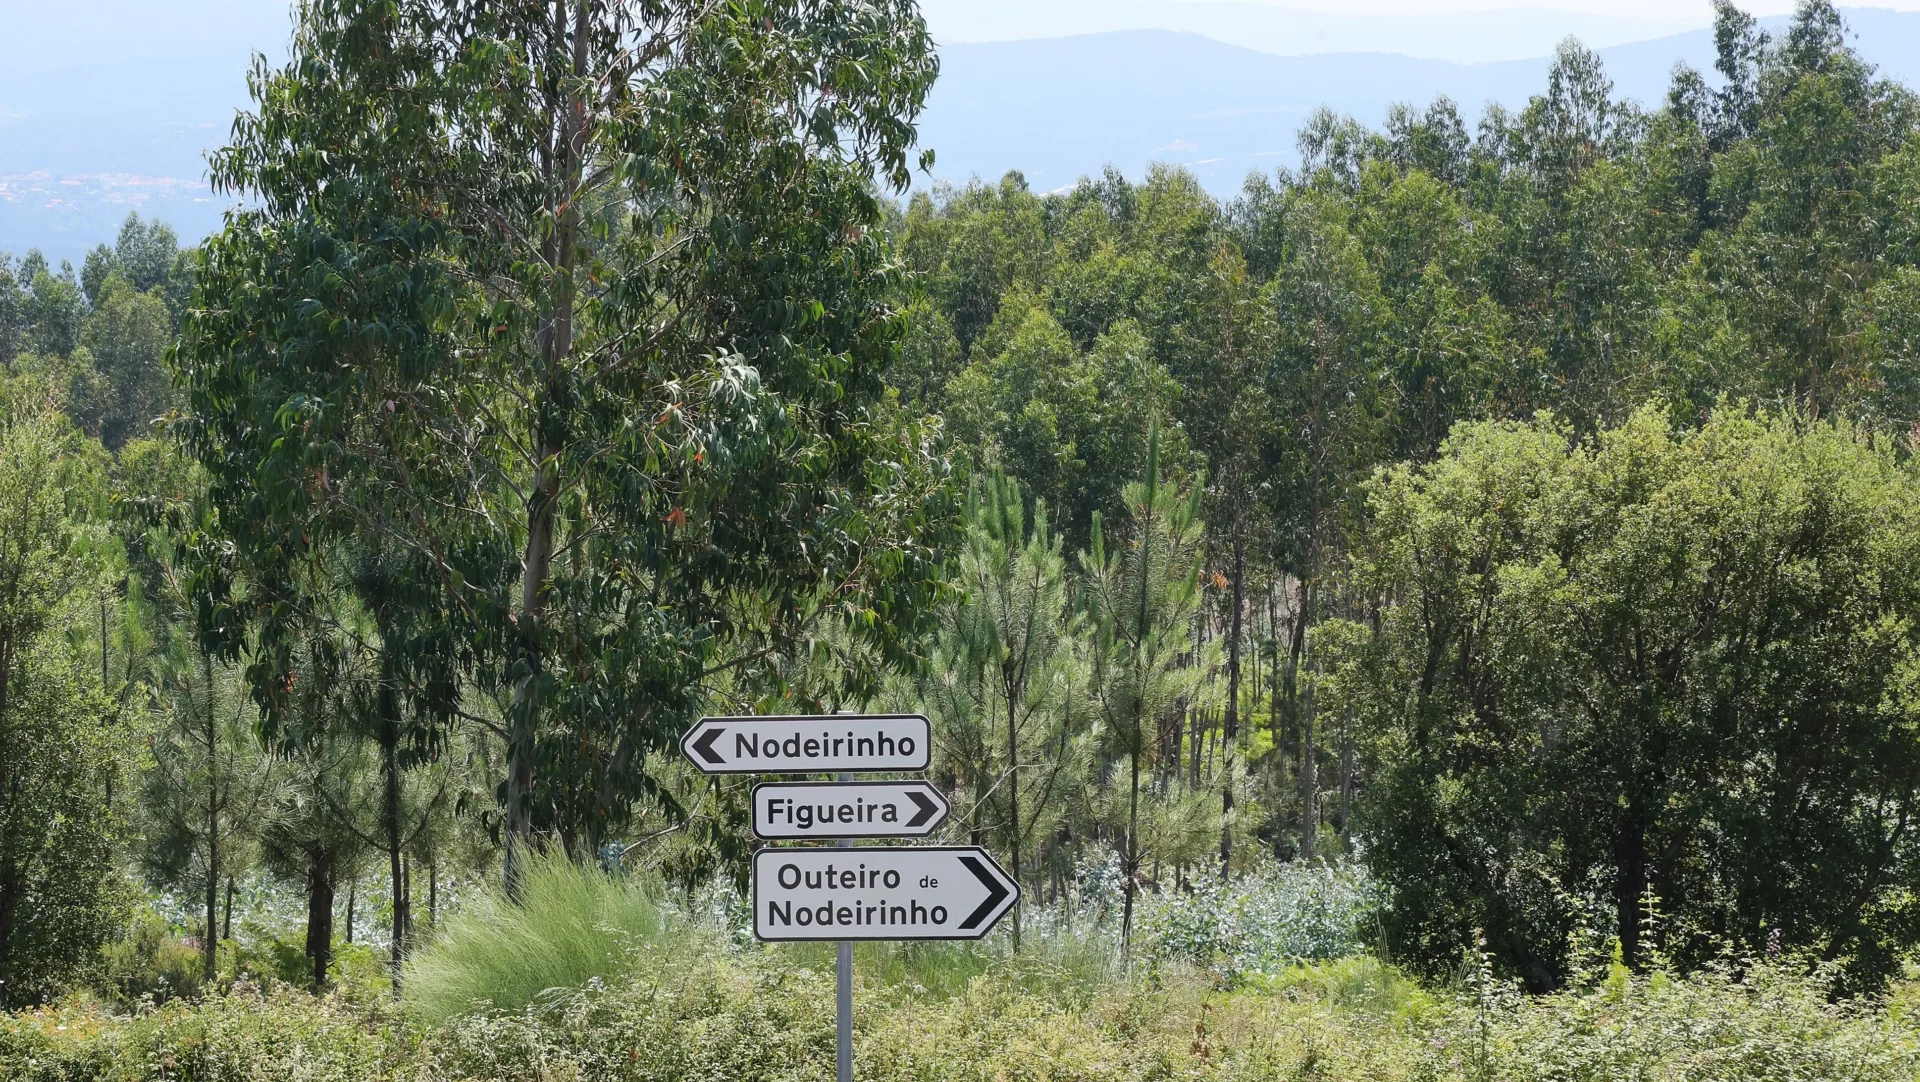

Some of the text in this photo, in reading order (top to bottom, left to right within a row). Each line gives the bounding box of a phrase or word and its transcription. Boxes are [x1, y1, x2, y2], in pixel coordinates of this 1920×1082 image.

[736, 731, 915, 758] Nodeirinho
[768, 798, 898, 829] Figueira
[778, 864, 938, 889] Outeiro de
[769, 900, 947, 926] Nodeirinho
